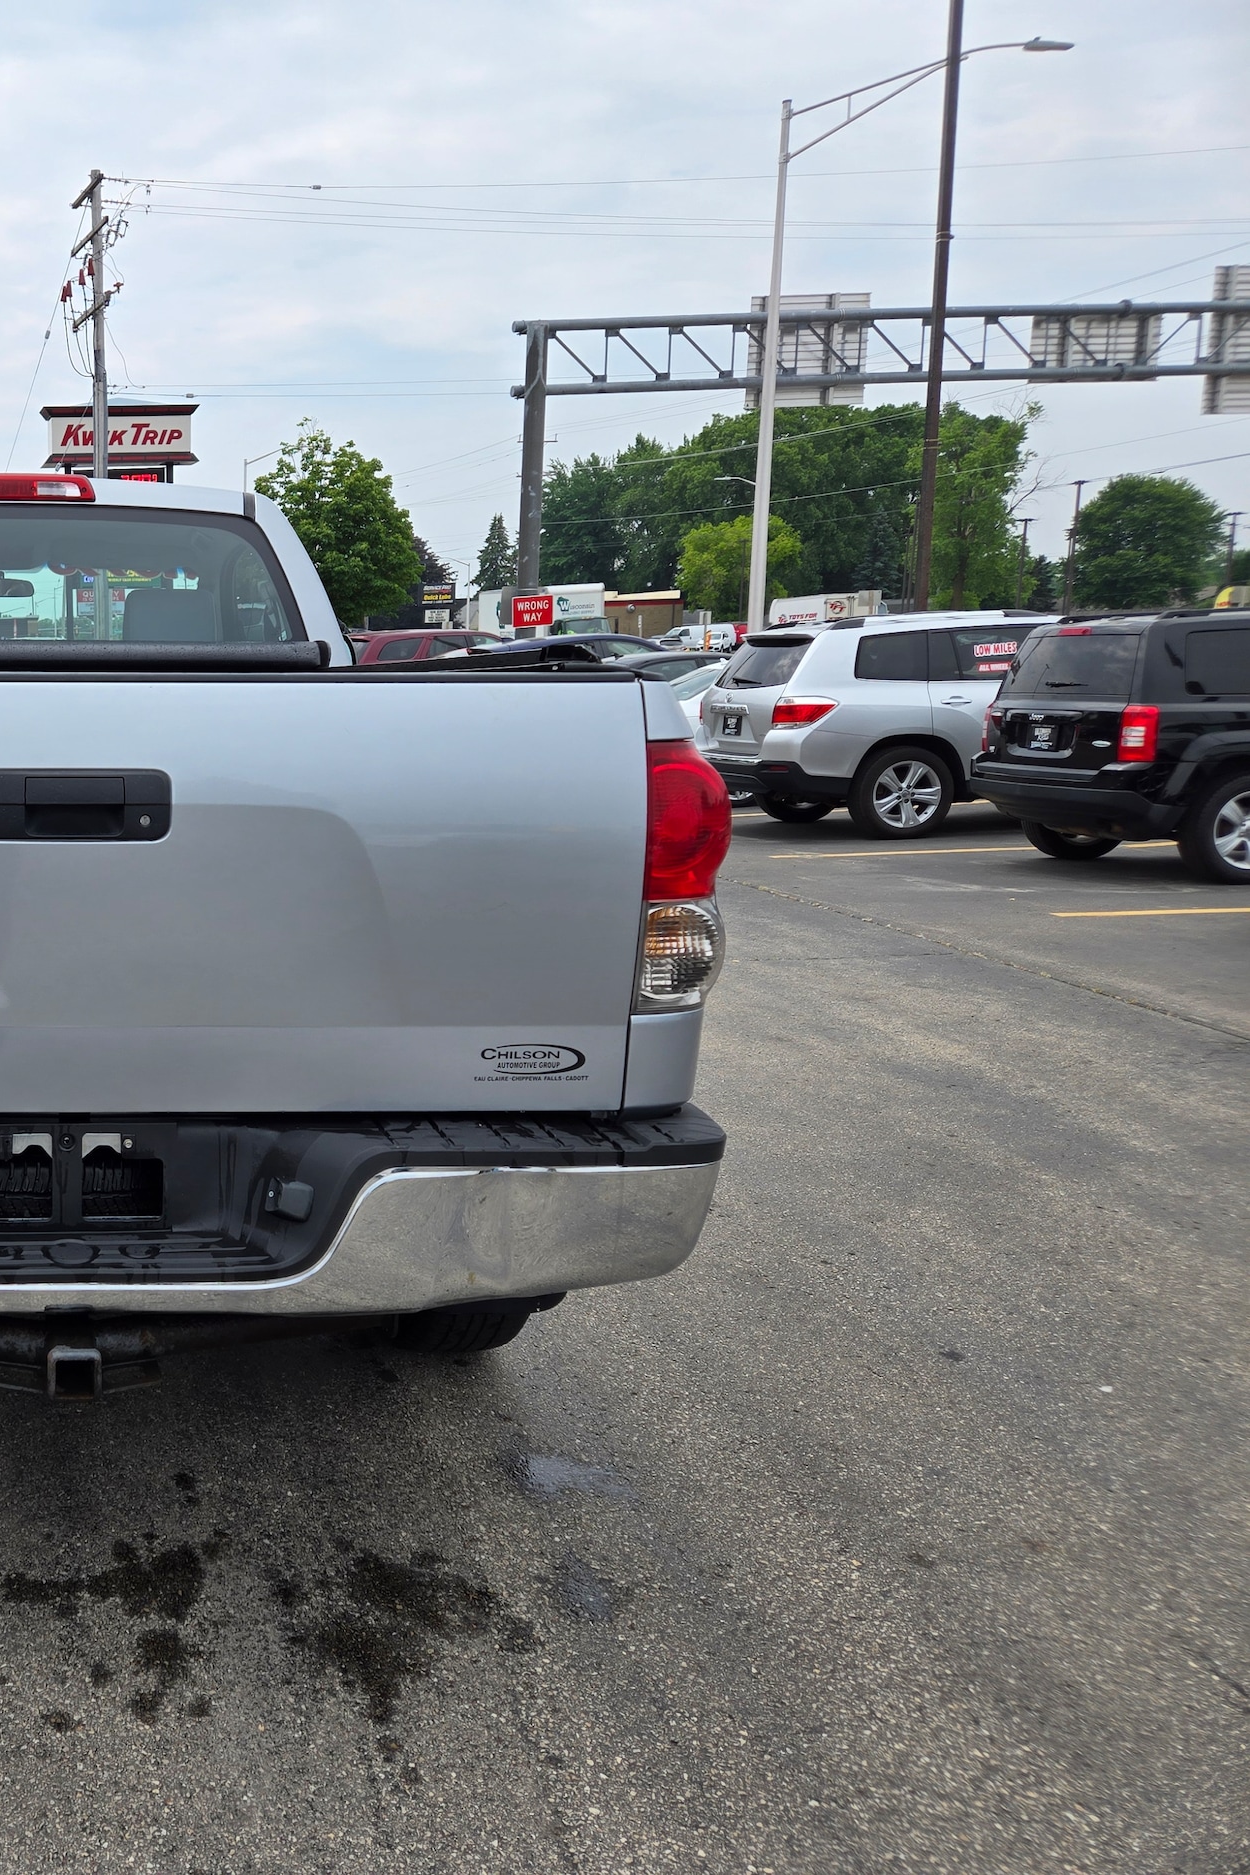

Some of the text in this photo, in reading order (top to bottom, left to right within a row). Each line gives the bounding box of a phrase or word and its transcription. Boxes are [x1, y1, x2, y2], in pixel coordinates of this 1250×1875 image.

[61, 423, 183, 446] KWK TRIP
[517, 599, 549, 611] WRONG
[523, 612, 542, 622] WAY
[975, 642, 1017, 656] LOW MILES
[1028, 713, 1045, 723] Jeep
[480, 1048, 560, 1060] CHILSON
[497, 1061, 561, 1069] AUTOMOTIVE GROUP
